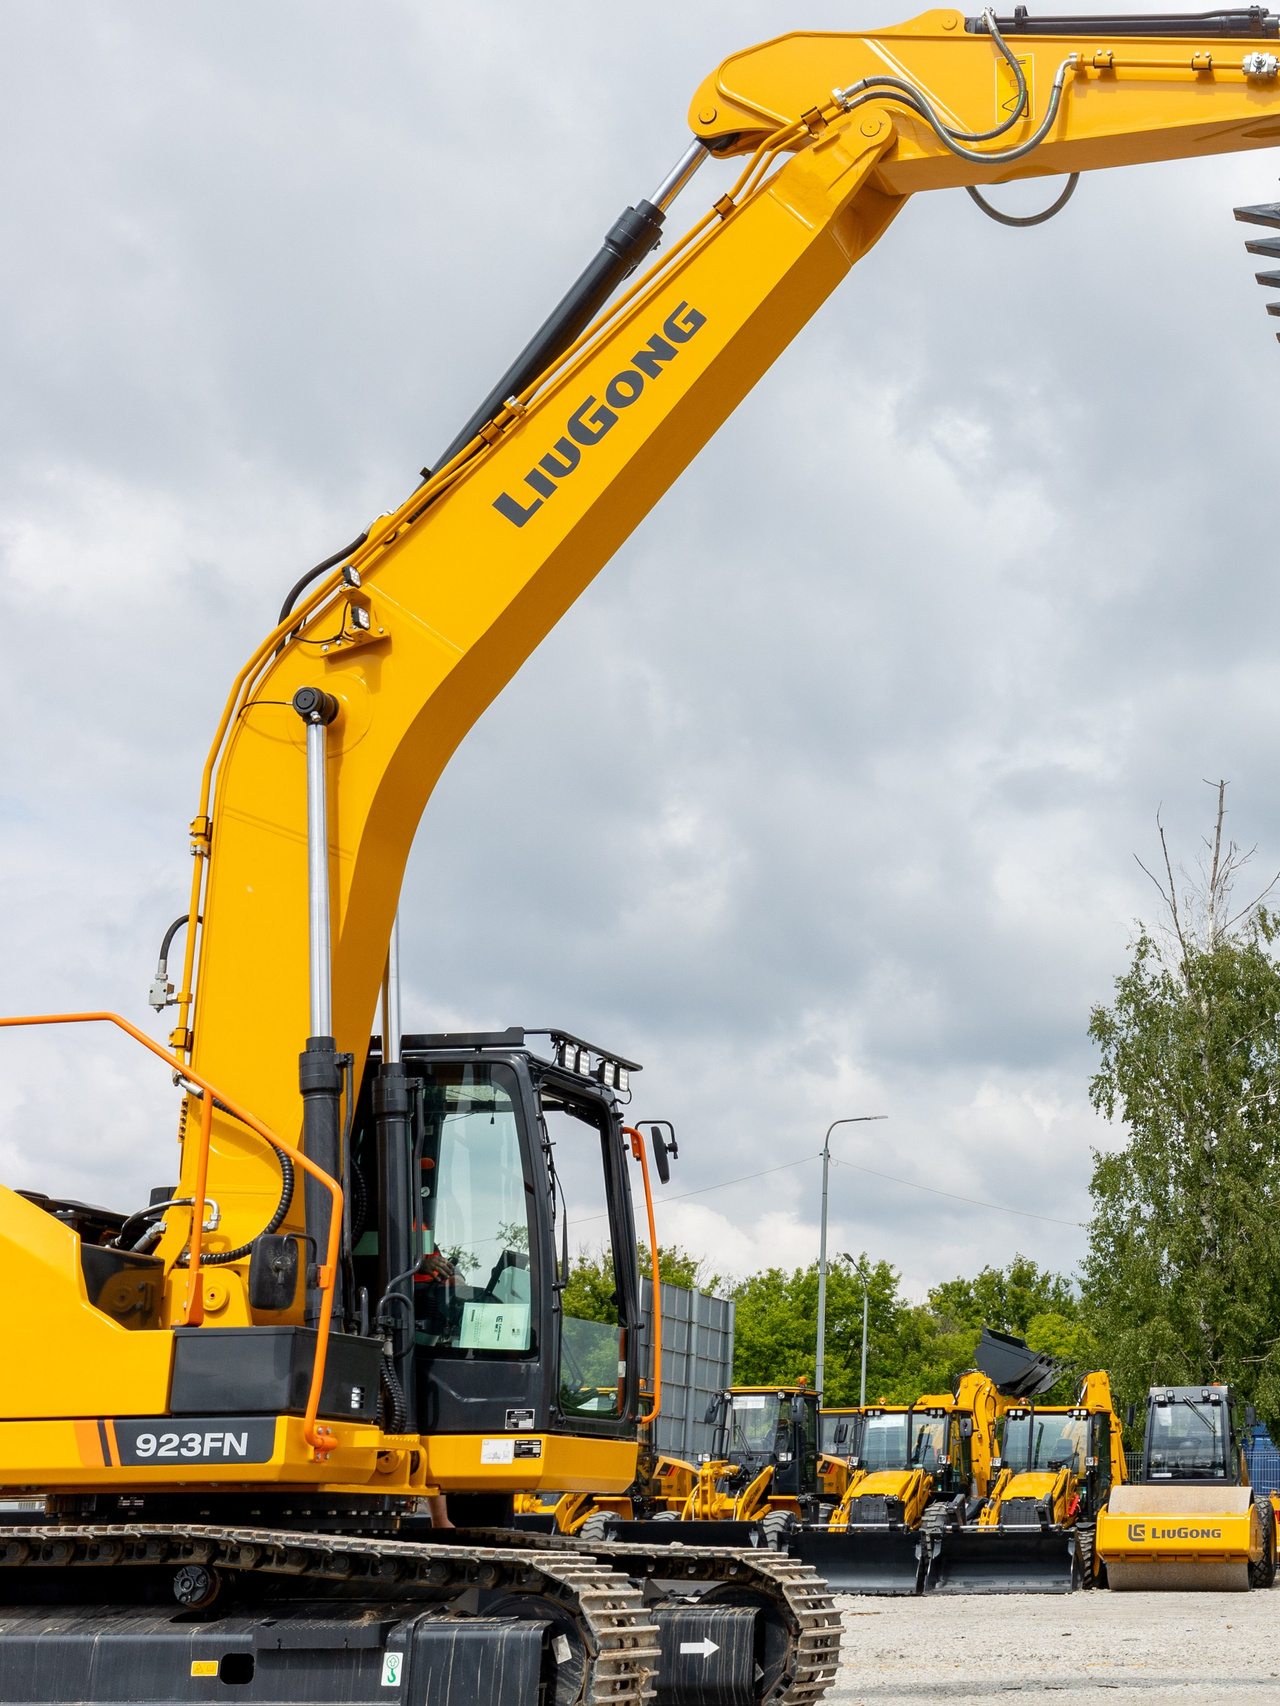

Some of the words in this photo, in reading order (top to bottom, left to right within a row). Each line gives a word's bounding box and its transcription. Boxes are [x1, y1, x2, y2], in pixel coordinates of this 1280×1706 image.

[492, 300, 707, 528] LIUGONG
[136, 1433, 248, 1457] 923FN
[1151, 1527, 1221, 1539] LIUGONG
